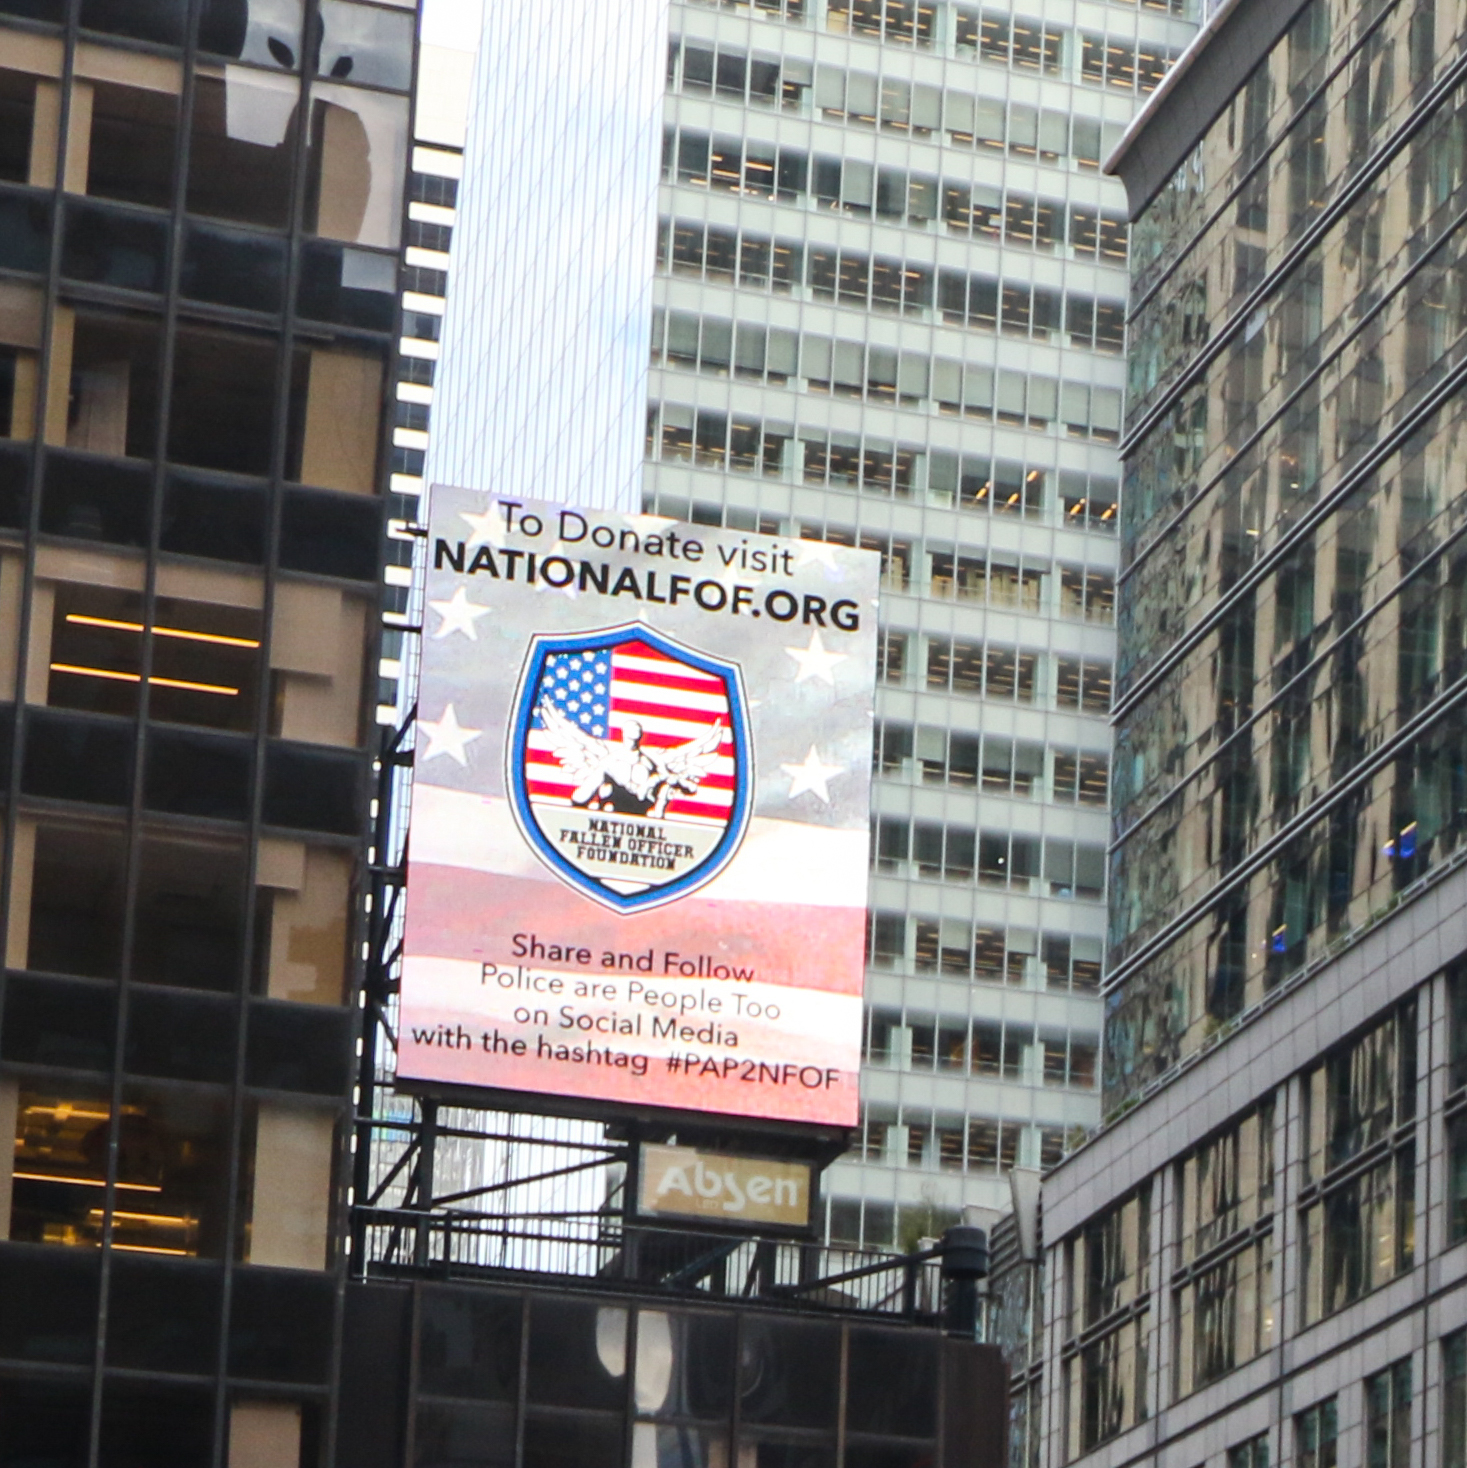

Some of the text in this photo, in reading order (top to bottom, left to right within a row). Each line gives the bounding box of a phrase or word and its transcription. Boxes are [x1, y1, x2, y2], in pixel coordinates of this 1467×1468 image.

[500, 500, 795, 578] To Donate visit
[433, 538, 861, 632] NATIONALFOF.ORG
[559, 828, 695, 859] FALLEN OFFICER
[588, 818, 667, 841] NATIONAL
[576, 845, 676, 870] FOUNDATION
[511, 932, 756, 983] Share and Follow
[480, 962, 782, 1021] Police are People Too
[513, 1005, 739, 1048] on Social Media
[411, 1024, 841, 1092] with the hashtag #PAP2NFOF
